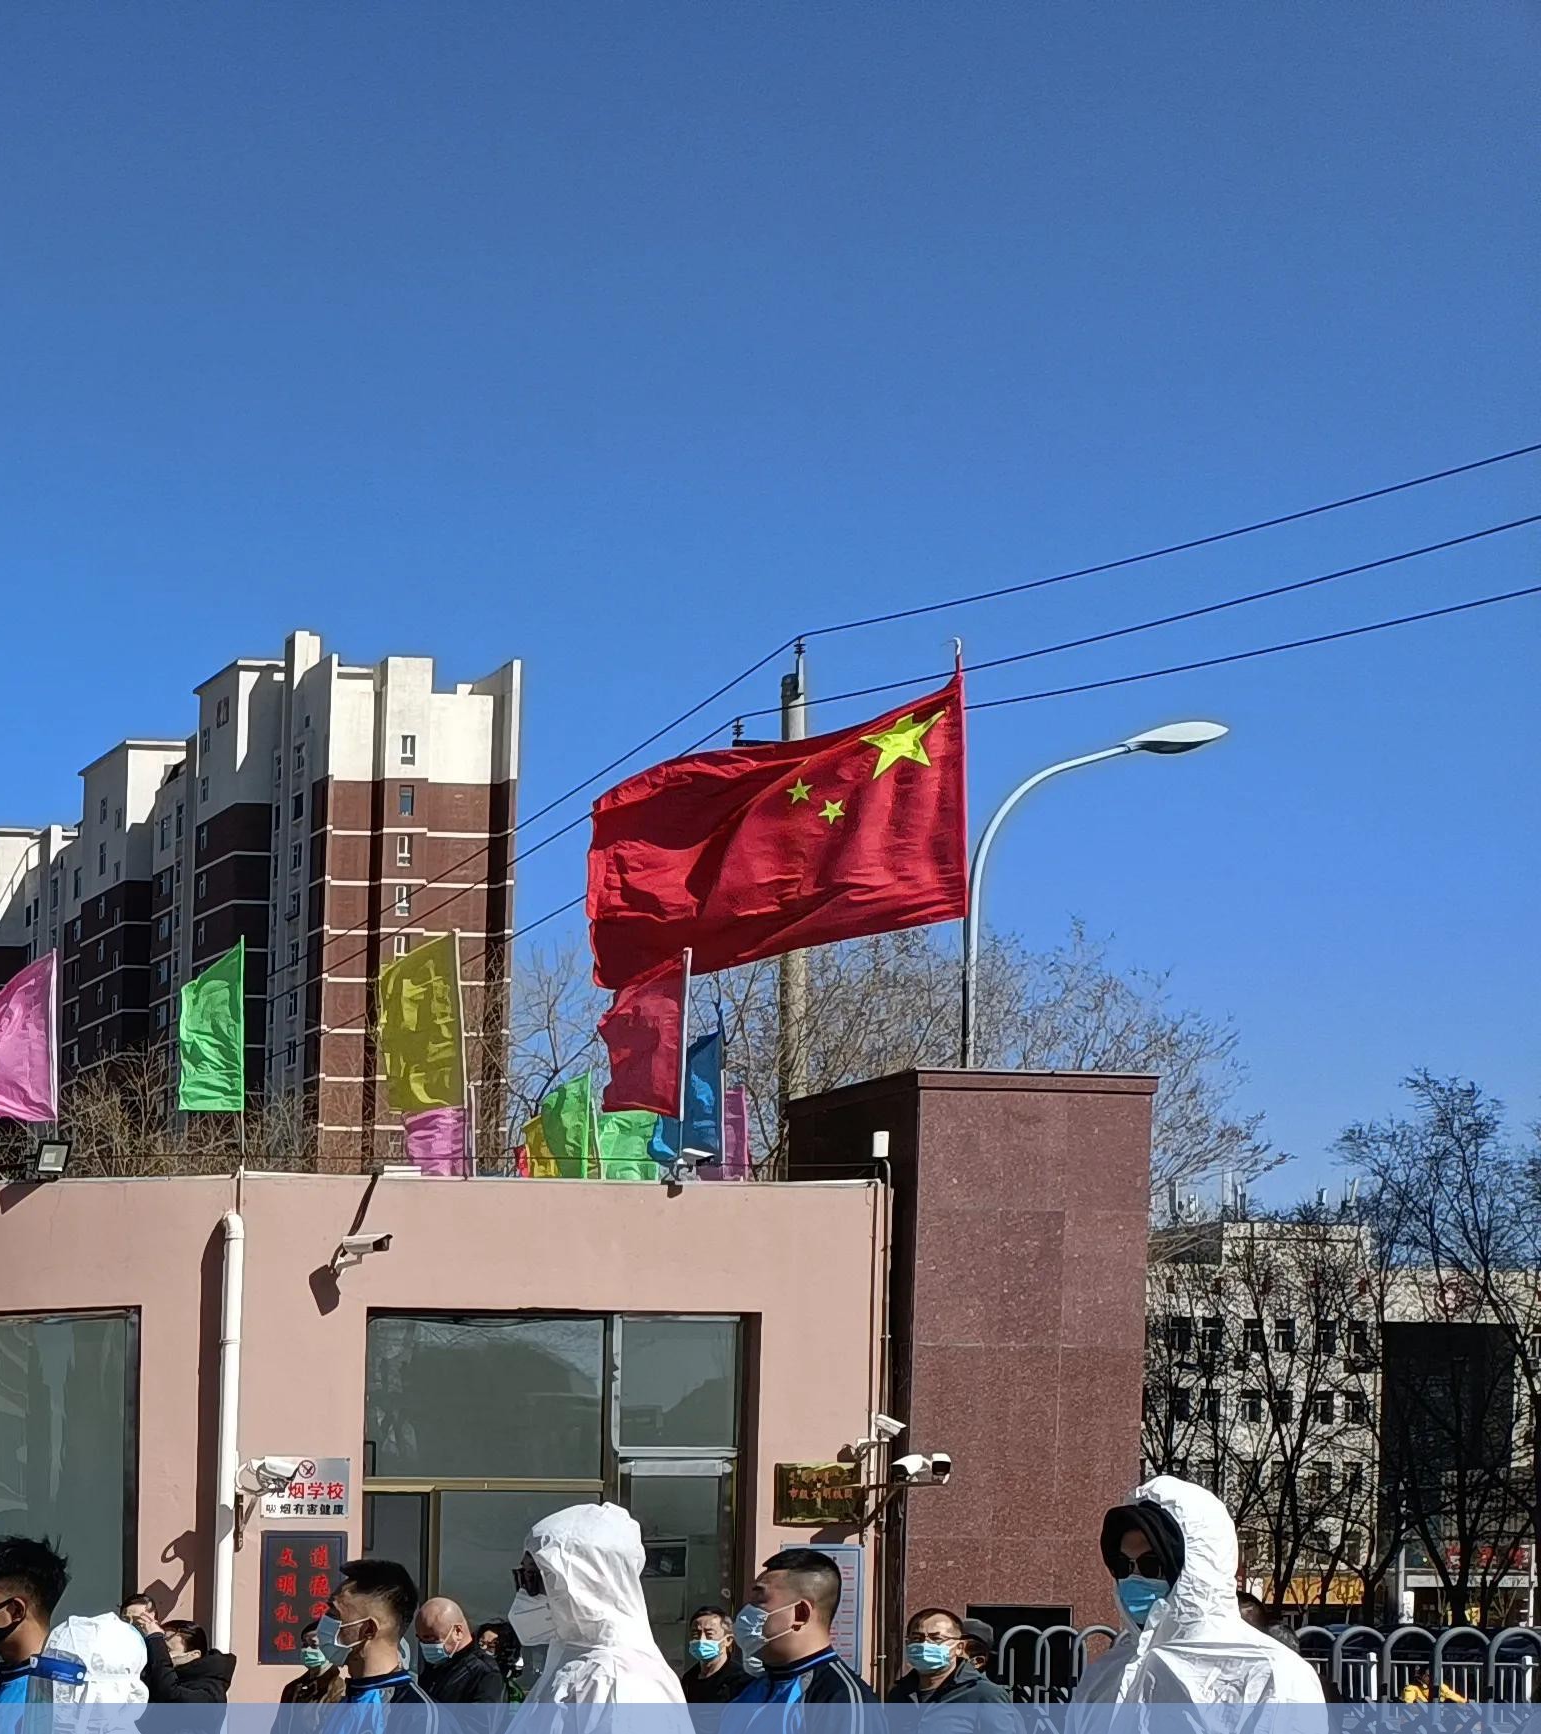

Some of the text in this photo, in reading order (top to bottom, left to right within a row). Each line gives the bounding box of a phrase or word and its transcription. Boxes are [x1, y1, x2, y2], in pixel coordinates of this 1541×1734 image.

[265, 1503, 345, 1516] 吸烟有害健康
